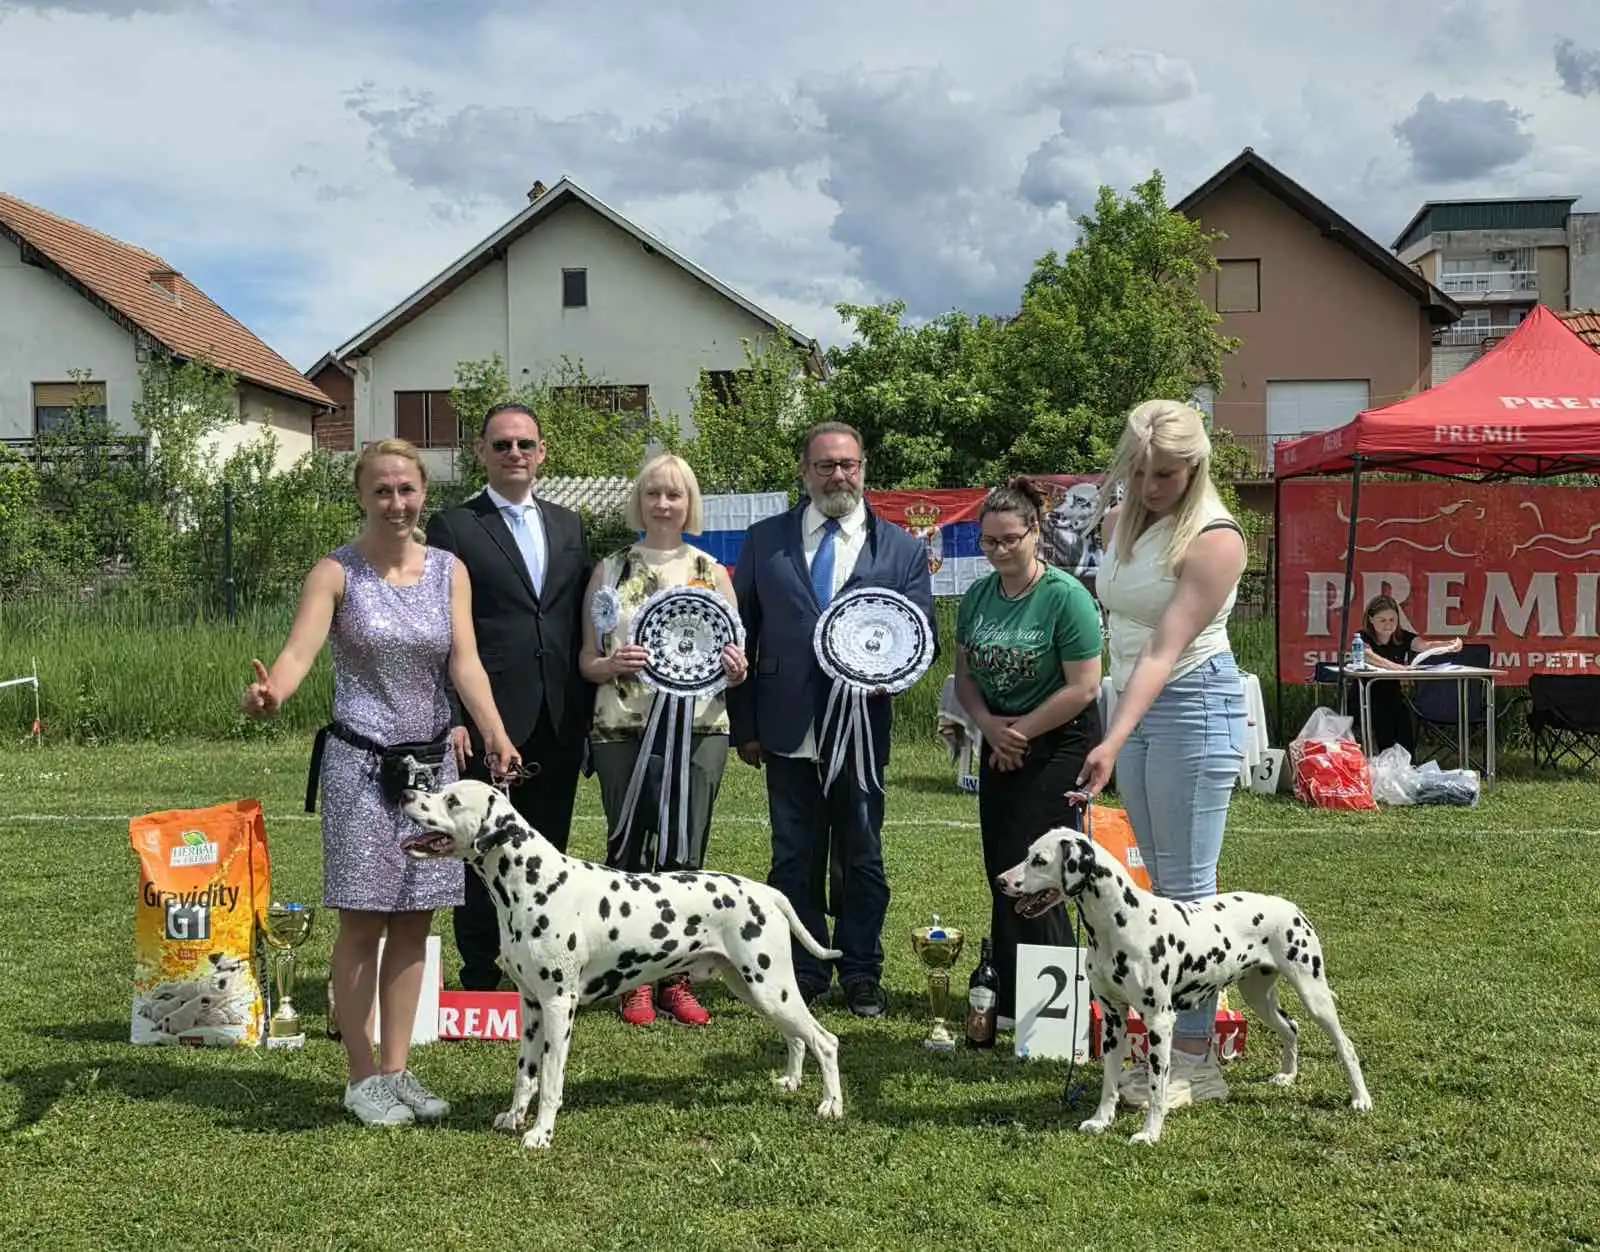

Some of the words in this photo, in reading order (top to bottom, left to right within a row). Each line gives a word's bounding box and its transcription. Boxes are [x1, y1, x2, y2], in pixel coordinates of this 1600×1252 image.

[1434, 425, 1527, 443] PREMIL
[1259, 757, 1274, 781] 3
[144, 881, 240, 912] Gravidity
[168, 903, 206, 939] G1
[1036, 965, 1070, 1019] 2
